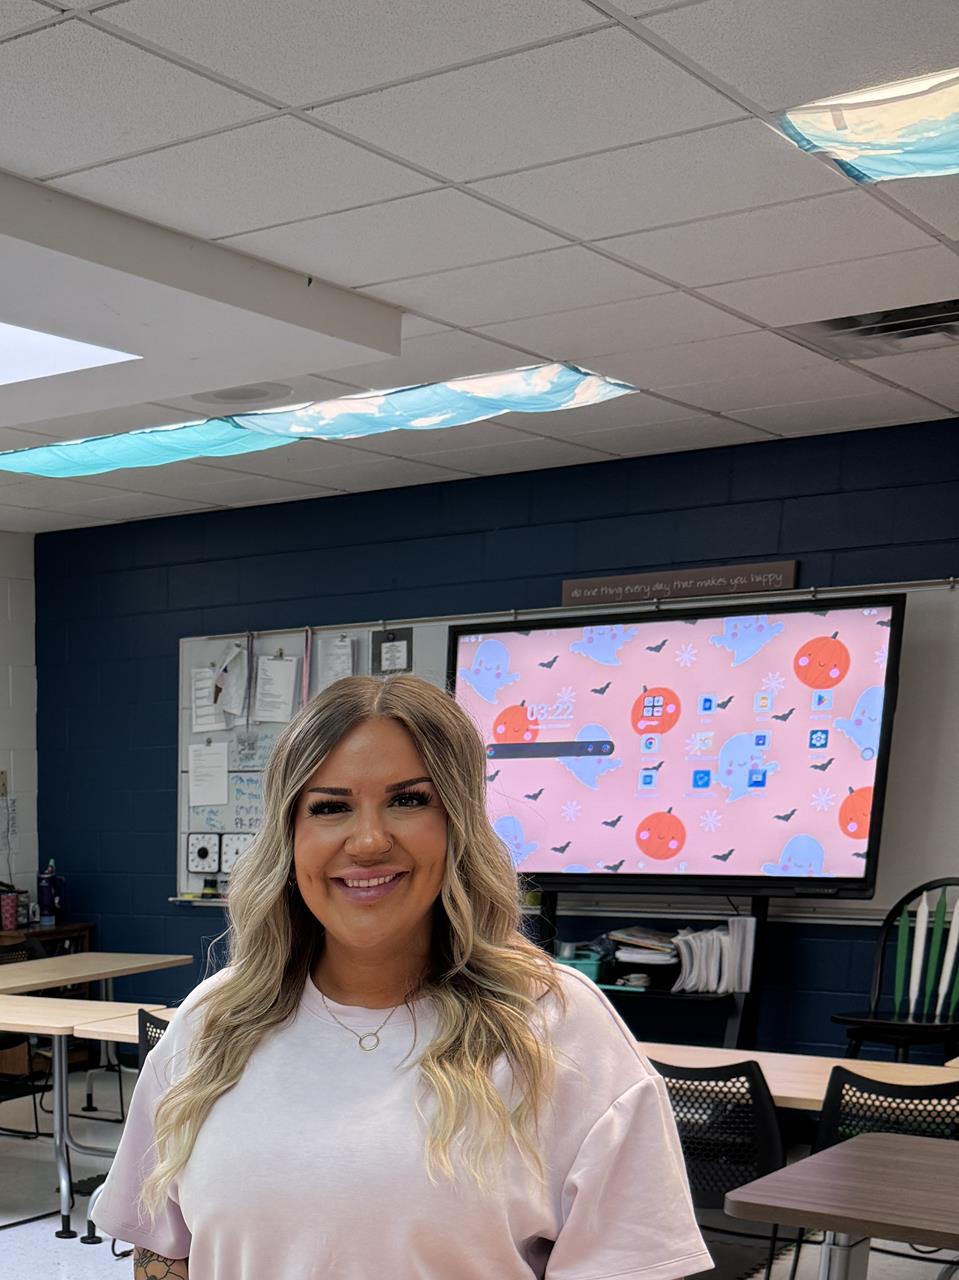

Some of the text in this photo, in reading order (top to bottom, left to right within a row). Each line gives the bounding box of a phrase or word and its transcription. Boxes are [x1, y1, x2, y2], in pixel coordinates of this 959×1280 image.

[571, 572, 783, 599] do one thing every day that makes you happy
[527, 703, 574, 720] 03:22
